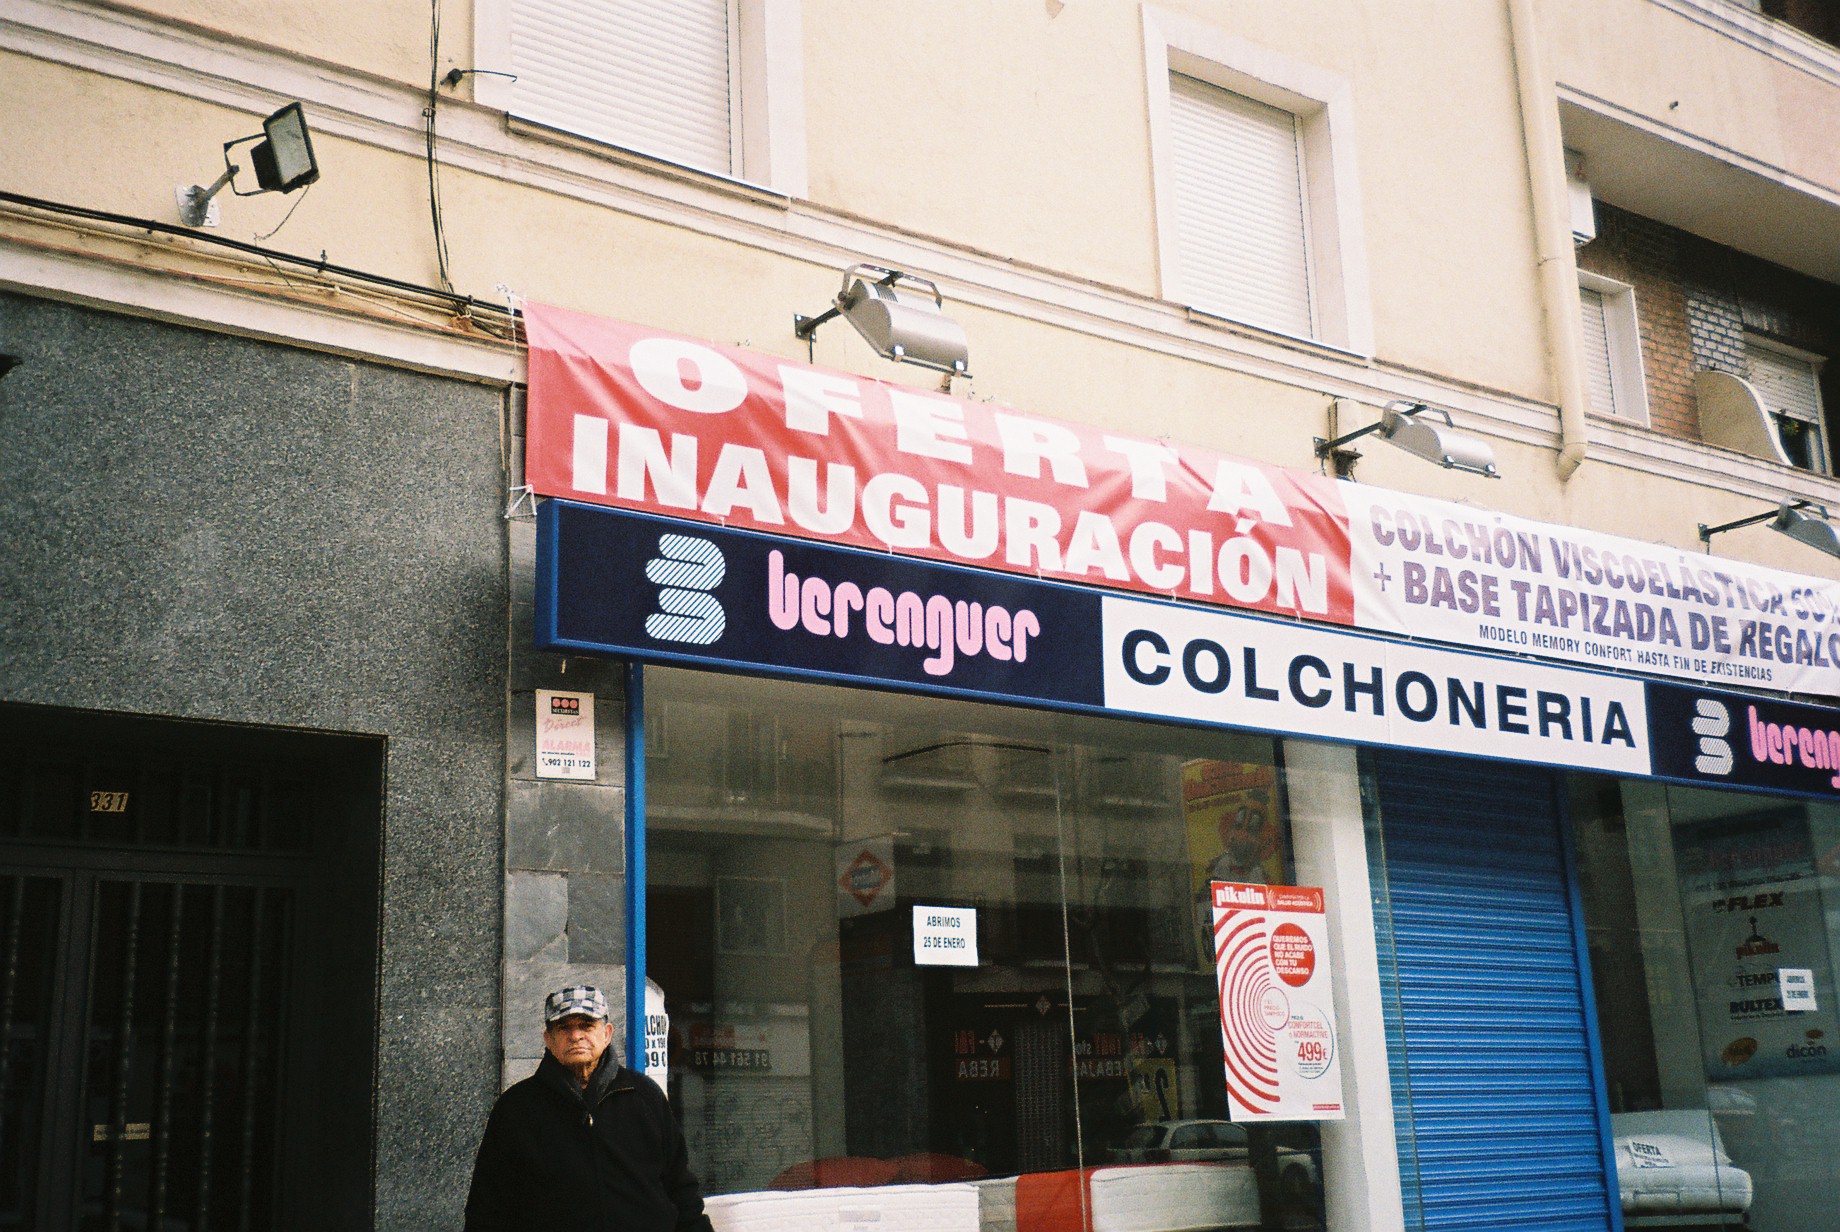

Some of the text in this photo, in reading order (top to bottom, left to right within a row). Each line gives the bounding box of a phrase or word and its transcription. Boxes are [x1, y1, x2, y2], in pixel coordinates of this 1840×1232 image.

[629, 338, 1294, 528] OFERTA
[572, 413, 1328, 614] INAUGURACIÓN
[1369, 504, 1543, 574] COLCHÓN
[1549, 536, 1788, 617] VISCOELÁSTICA
[768, 550, 1041, 676] berenguer
[1403, 560, 1501, 617] BASE
[1510, 579, 1682, 648] TAPIZADA
[1688, 611, 1731, 654] DE
[1121, 629, 1636, 749] COLCHONERIA
[1479, 624, 1773, 682] MODELO MEMORY CONFORT HASTA FIN DE EXISTENCIAS
[548, 758, 561, 766] 902
[564, 759, 575, 767] 121
[90, 792, 125, 811] 331
[927, 915, 961, 928] ABRIMOS
[1727, 891, 1784, 912] FLEX
[923, 936, 966, 949] 25 DE ENERO
